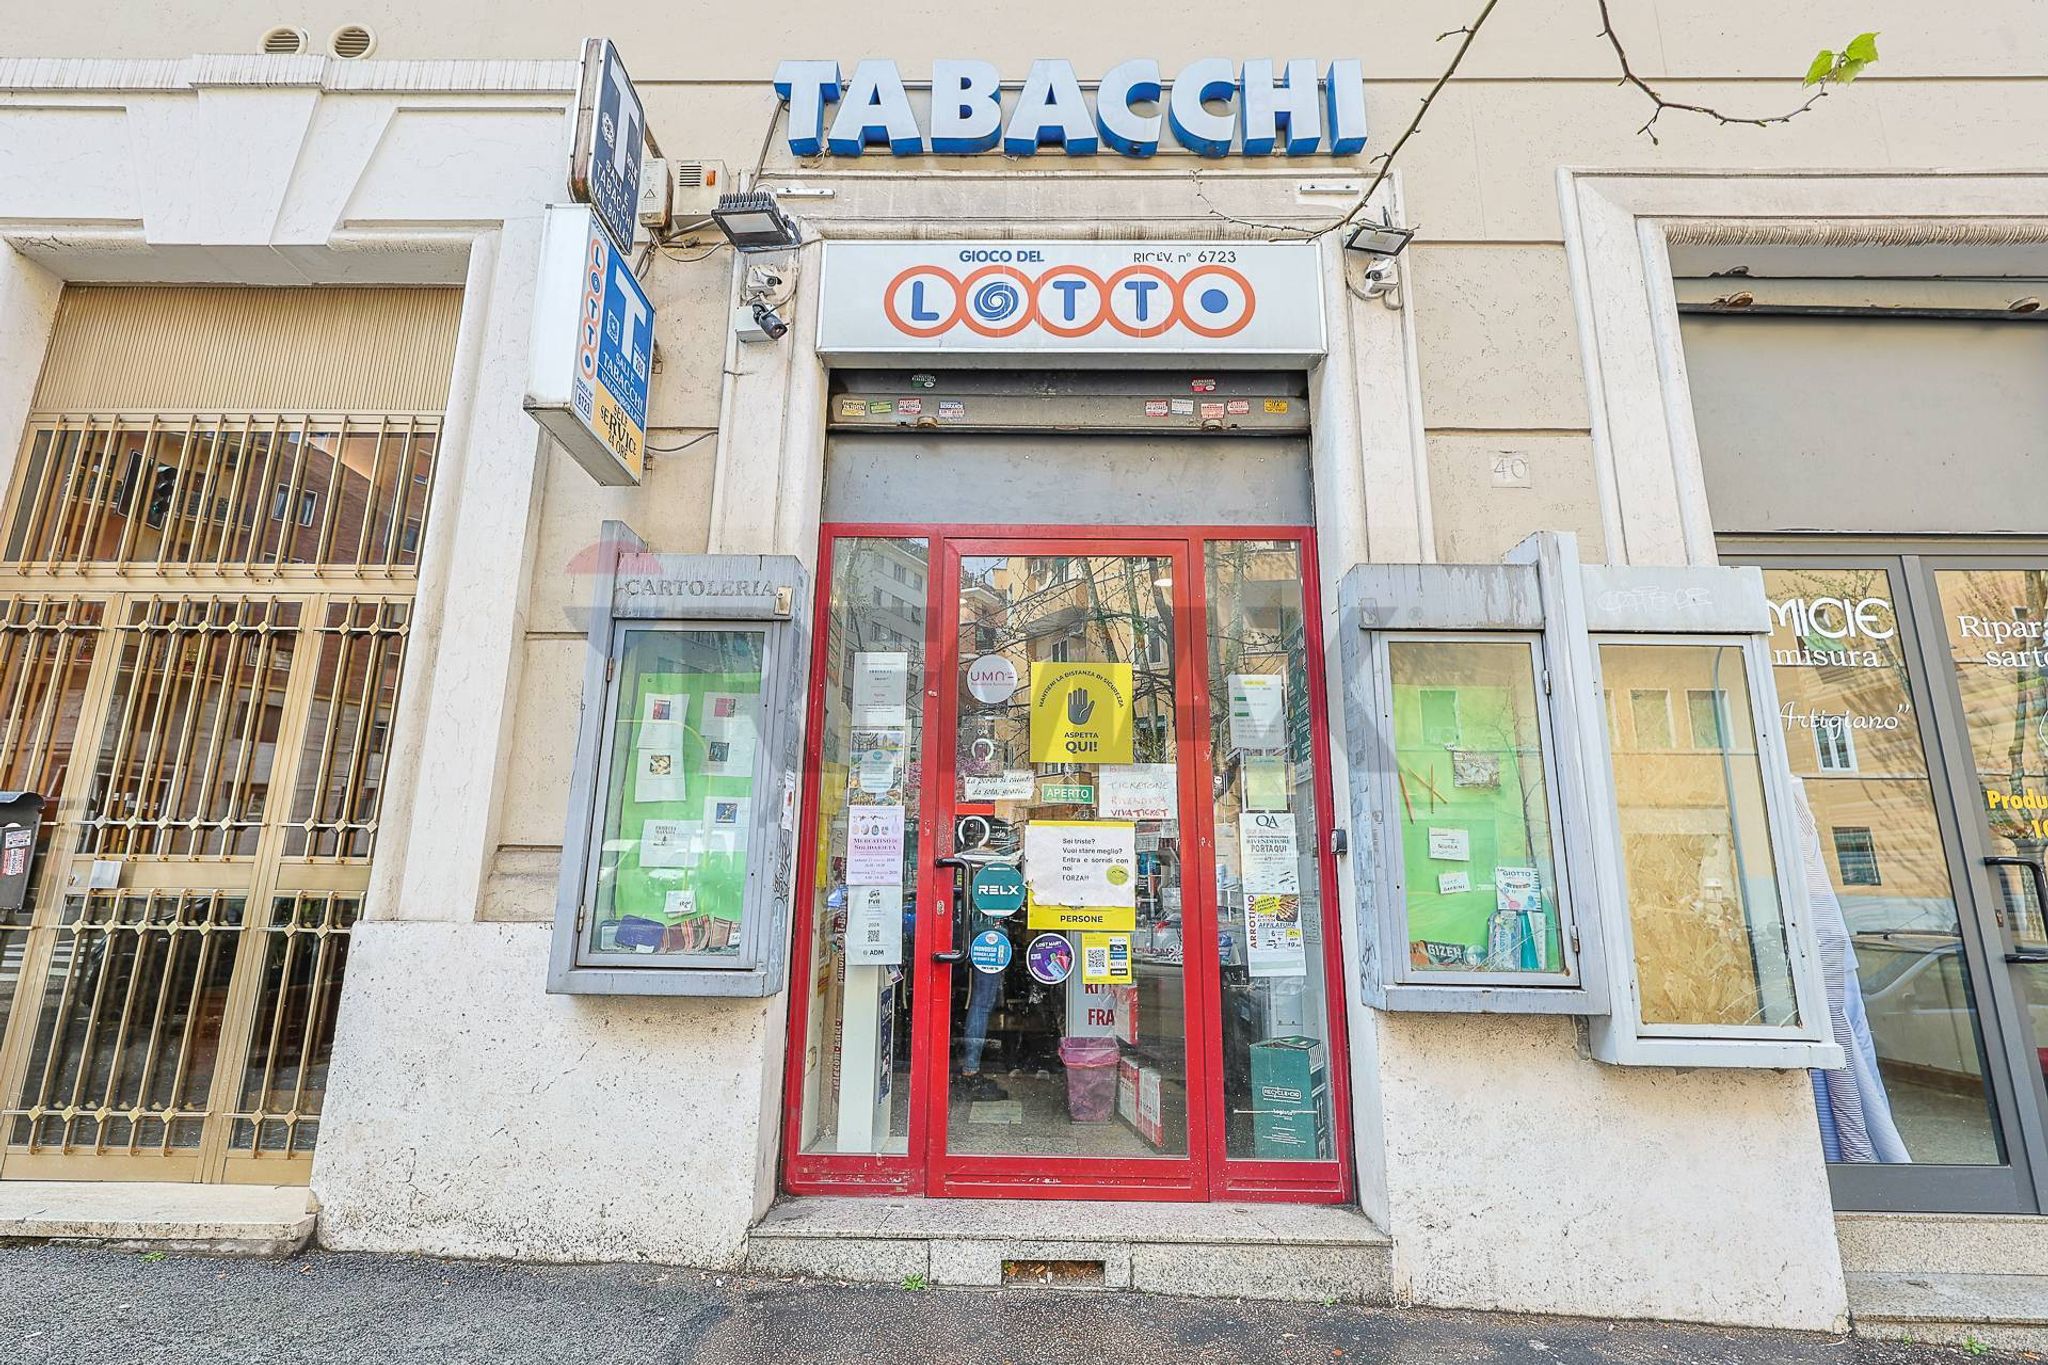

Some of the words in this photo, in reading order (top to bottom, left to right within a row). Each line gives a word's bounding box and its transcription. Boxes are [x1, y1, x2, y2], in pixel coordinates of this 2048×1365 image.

[774, 58, 1368, 158] TABACCHI
[596, 160, 633, 232] TABACCHI
[959, 250, 1012, 263] GIOCO
[1016, 250, 1045, 263] DEL
[1197, 250, 1237, 263] 6723
[897, 272, 1242, 330] LOTTO
[602, 352, 643, 413] TABACCHI
[624, 579, 776, 597] CARTOLERIA
[1775, 648, 1881, 667] misura
[1065, 731, 1099, 739] ASPETTA
[1065, 741, 1098, 754] QUI!
[1046, 785, 1089, 799] APERTO
[1111, 808, 1169, 817] VIVATICKET
[1255, 814, 1279, 829] QA
[1096, 848, 1123, 856] meglio?
[1251, 844, 1287, 853] PORTAQUI
[978, 885, 1019, 895] RELX
[1060, 915, 1103, 923] PERSONE
[1248, 895, 1257, 949] ARROTINO
[1427, 944, 1462, 959] GIZEH
